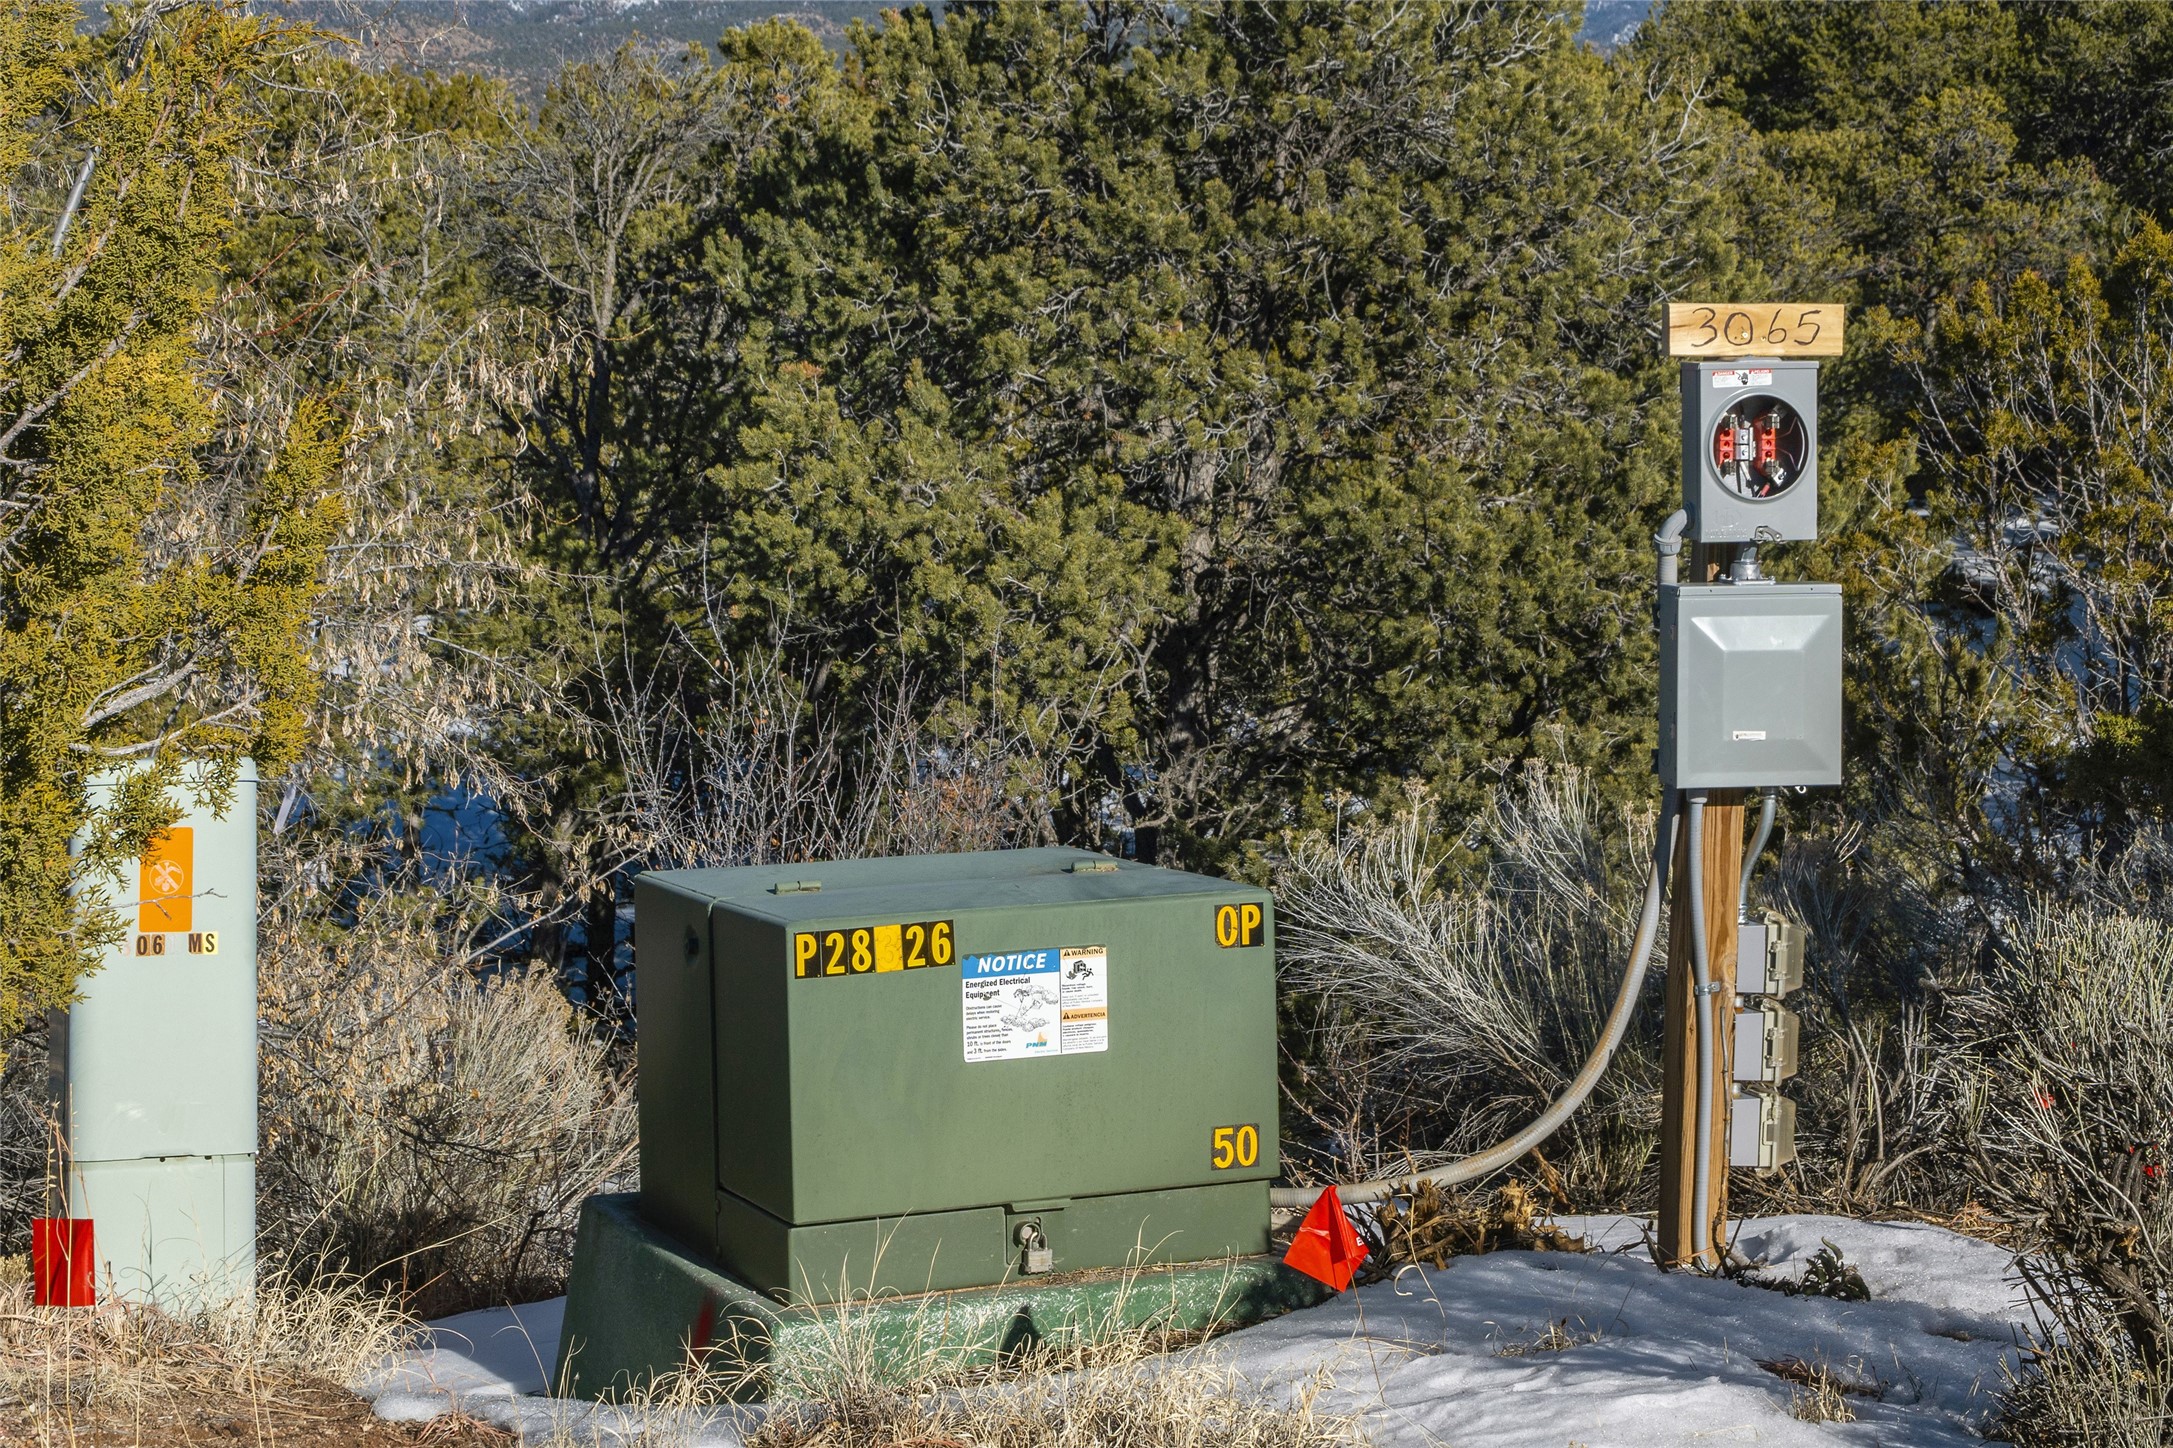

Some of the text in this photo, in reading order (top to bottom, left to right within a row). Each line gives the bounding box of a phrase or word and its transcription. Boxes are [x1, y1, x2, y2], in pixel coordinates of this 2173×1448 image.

[1691, 307, 1821, 347] 3065
[188, 933, 215, 953] MS
[1071, 948, 1104, 956] WARNING
[977, 953, 1047, 974] NOTICE
[965, 977, 1031, 989] Energized Electrical
[1070, 1012, 1106, 1020] ADVERTENCIA
[1213, 1125, 1258, 1169] 50
